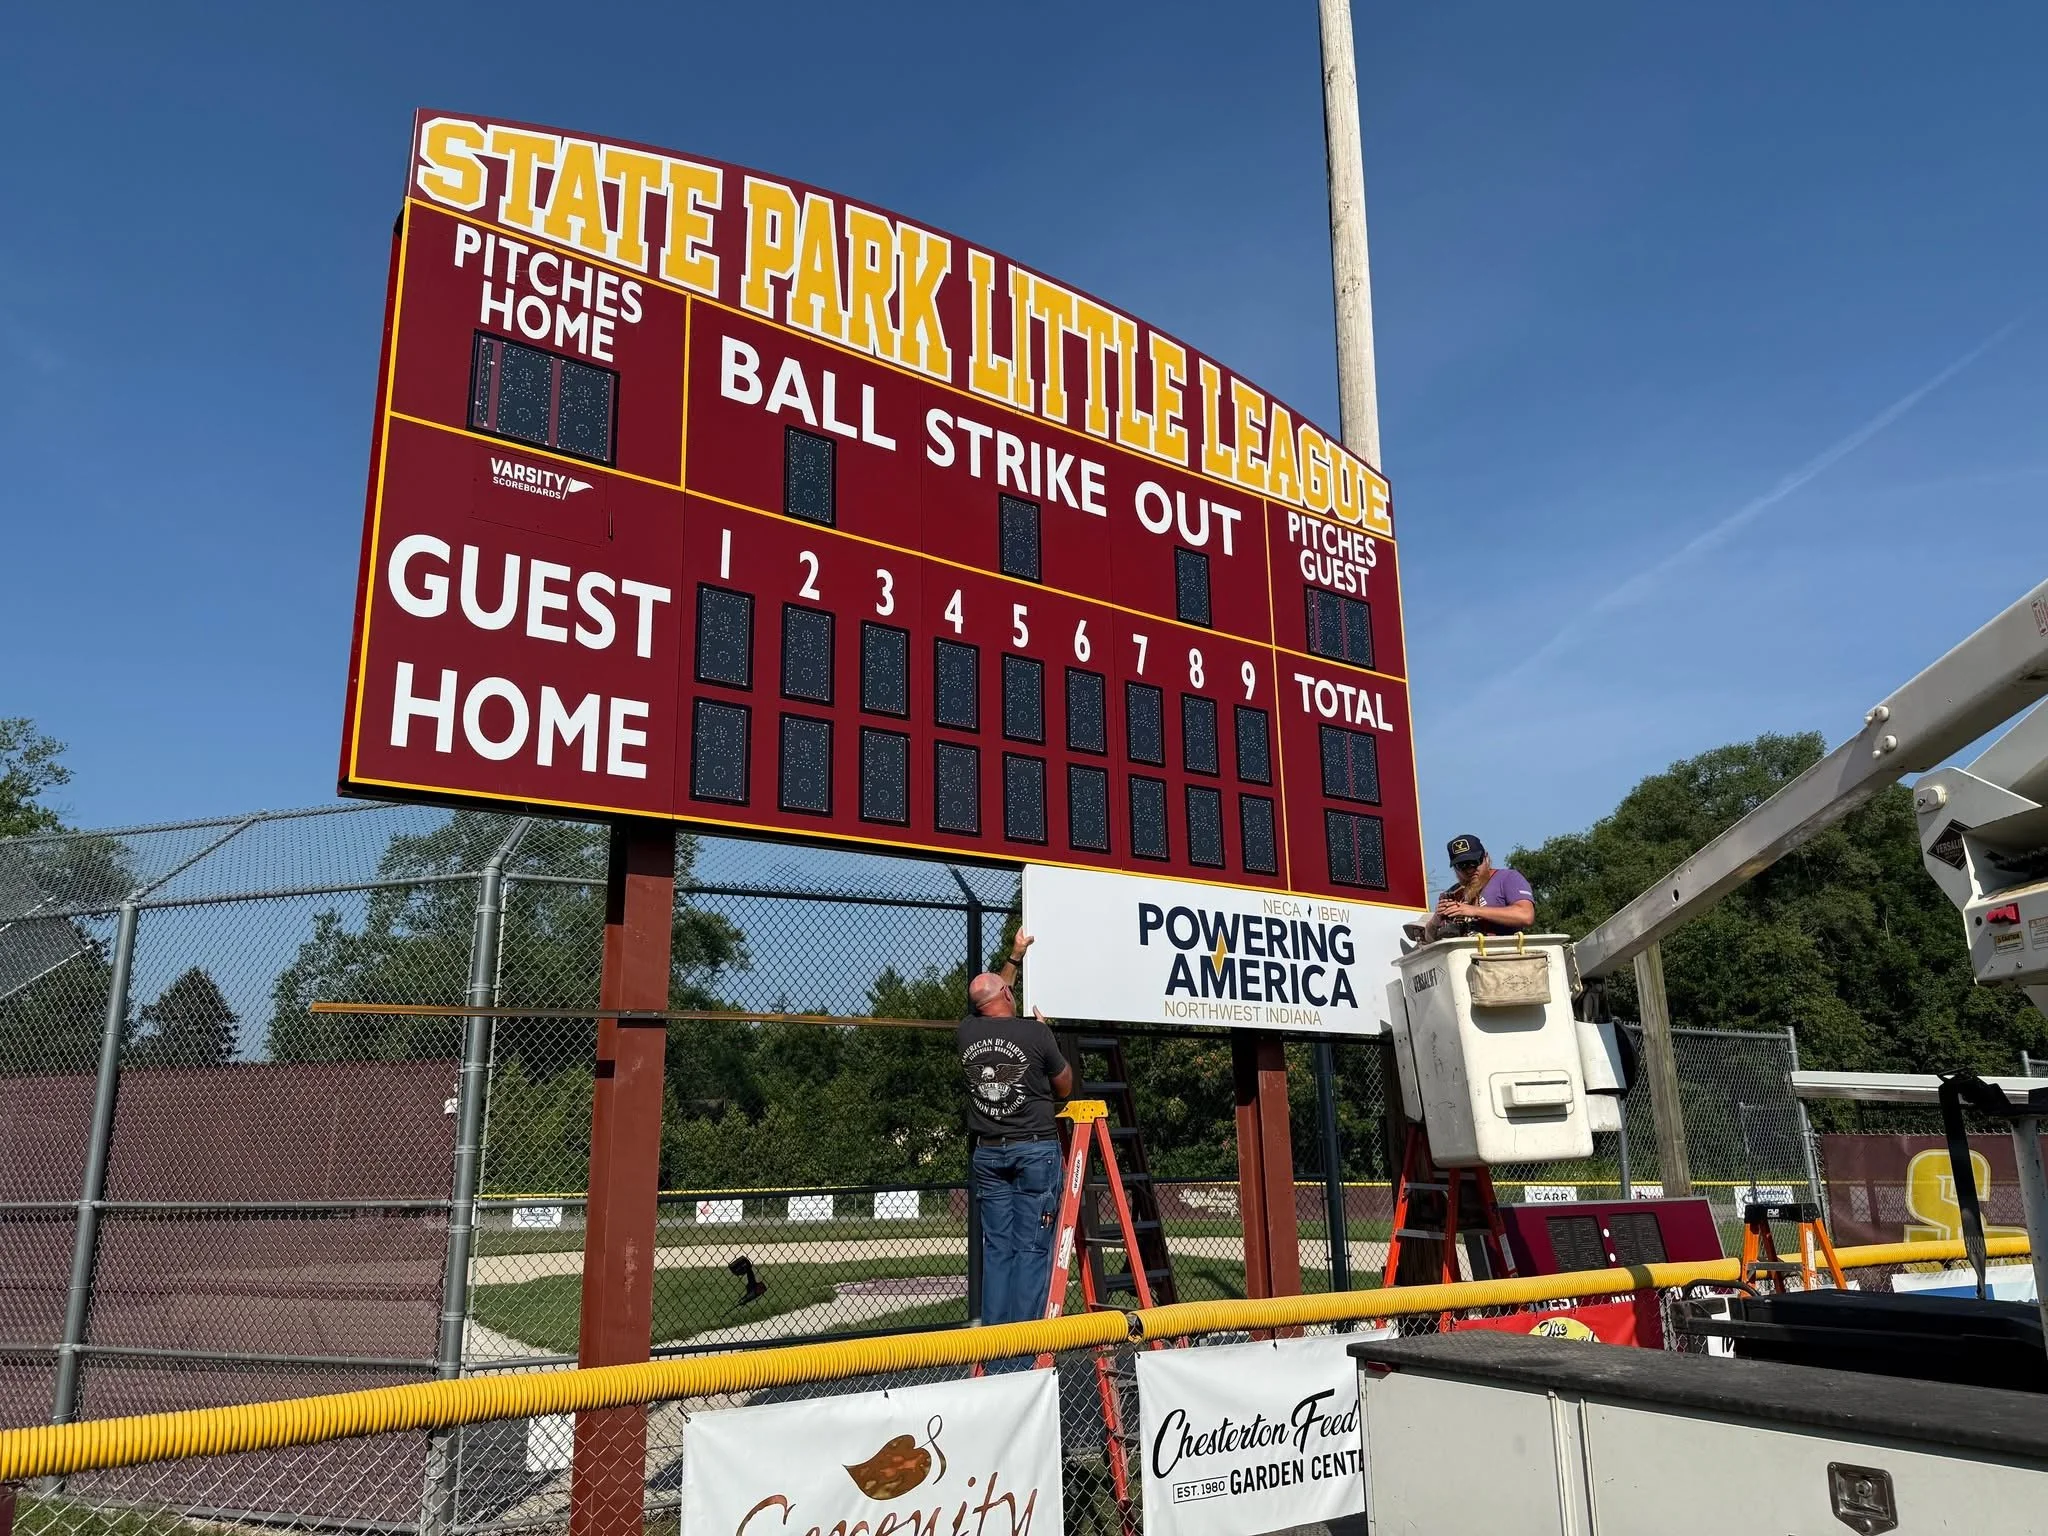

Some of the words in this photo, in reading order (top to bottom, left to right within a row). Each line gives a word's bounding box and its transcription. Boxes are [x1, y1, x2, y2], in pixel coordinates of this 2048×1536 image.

[454, 224, 643, 324] PITCHES
[417, 117, 723, 298] STATE
[741, 175, 952, 383] PARK
[968, 247, 1189, 466] LITTLE
[1199, 357, 1392, 537] LEAGUE
[480, 280, 615, 362] HOME
[721, 334, 898, 451] BALL
[926, 408, 1108, 517] STRIKE
[1135, 481, 1242, 556] OUT
[490, 457, 566, 491] VARSITY
[492, 475, 561, 499] SCOREBOARDS
[1288, 512, 1376, 569] PITCHES
[388, 534, 671, 659] GUEST
[1299, 549, 1370, 597] GUEST
[720, 528, 732, 580] 1
[799, 550, 820, 601] 2
[876, 568, 895, 616] 3
[944, 589, 964, 634] 4
[1012, 603, 1029, 648] 5
[1074, 619, 1091, 663] 6
[1132, 633, 1148, 676] 7
[1188, 648, 1205, 689] 8
[1241, 660, 1256, 700] 9
[390, 661, 650, 779] HOME
[1294, 673, 1394, 732] TOTAL
[1138, 902, 1355, 966] POWERING
[1263, 899, 1301, 917] NECA
[1317, 907, 1350, 923] IBEW
[1165, 953, 1359, 1009] AMERICA
[1164, 1001, 1261, 1023] NORTHWEST
[1265, 1007, 1322, 1026] INDIANA
[961, 1038, 993, 1065] AMERICAN
[995, 1038, 1006, 1046] BY
[1006, 1041, 1028, 1063] BIRTH
[973, 1096, 989, 1114] NION
[990, 1107, 1001, 1116] BY
[1002, 1095, 1026, 1115] CHOICE
[1534, 1192, 1568, 1201] CARR
[1152, 1408, 1290, 1479] Chesterton
[1291, 1388, 1359, 1454] Feed
[1177, 1484, 1200, 1498] EST.
[1201, 1480, 1226, 1495] 1980
[1230, 1459, 1304, 1495] GARDEN
